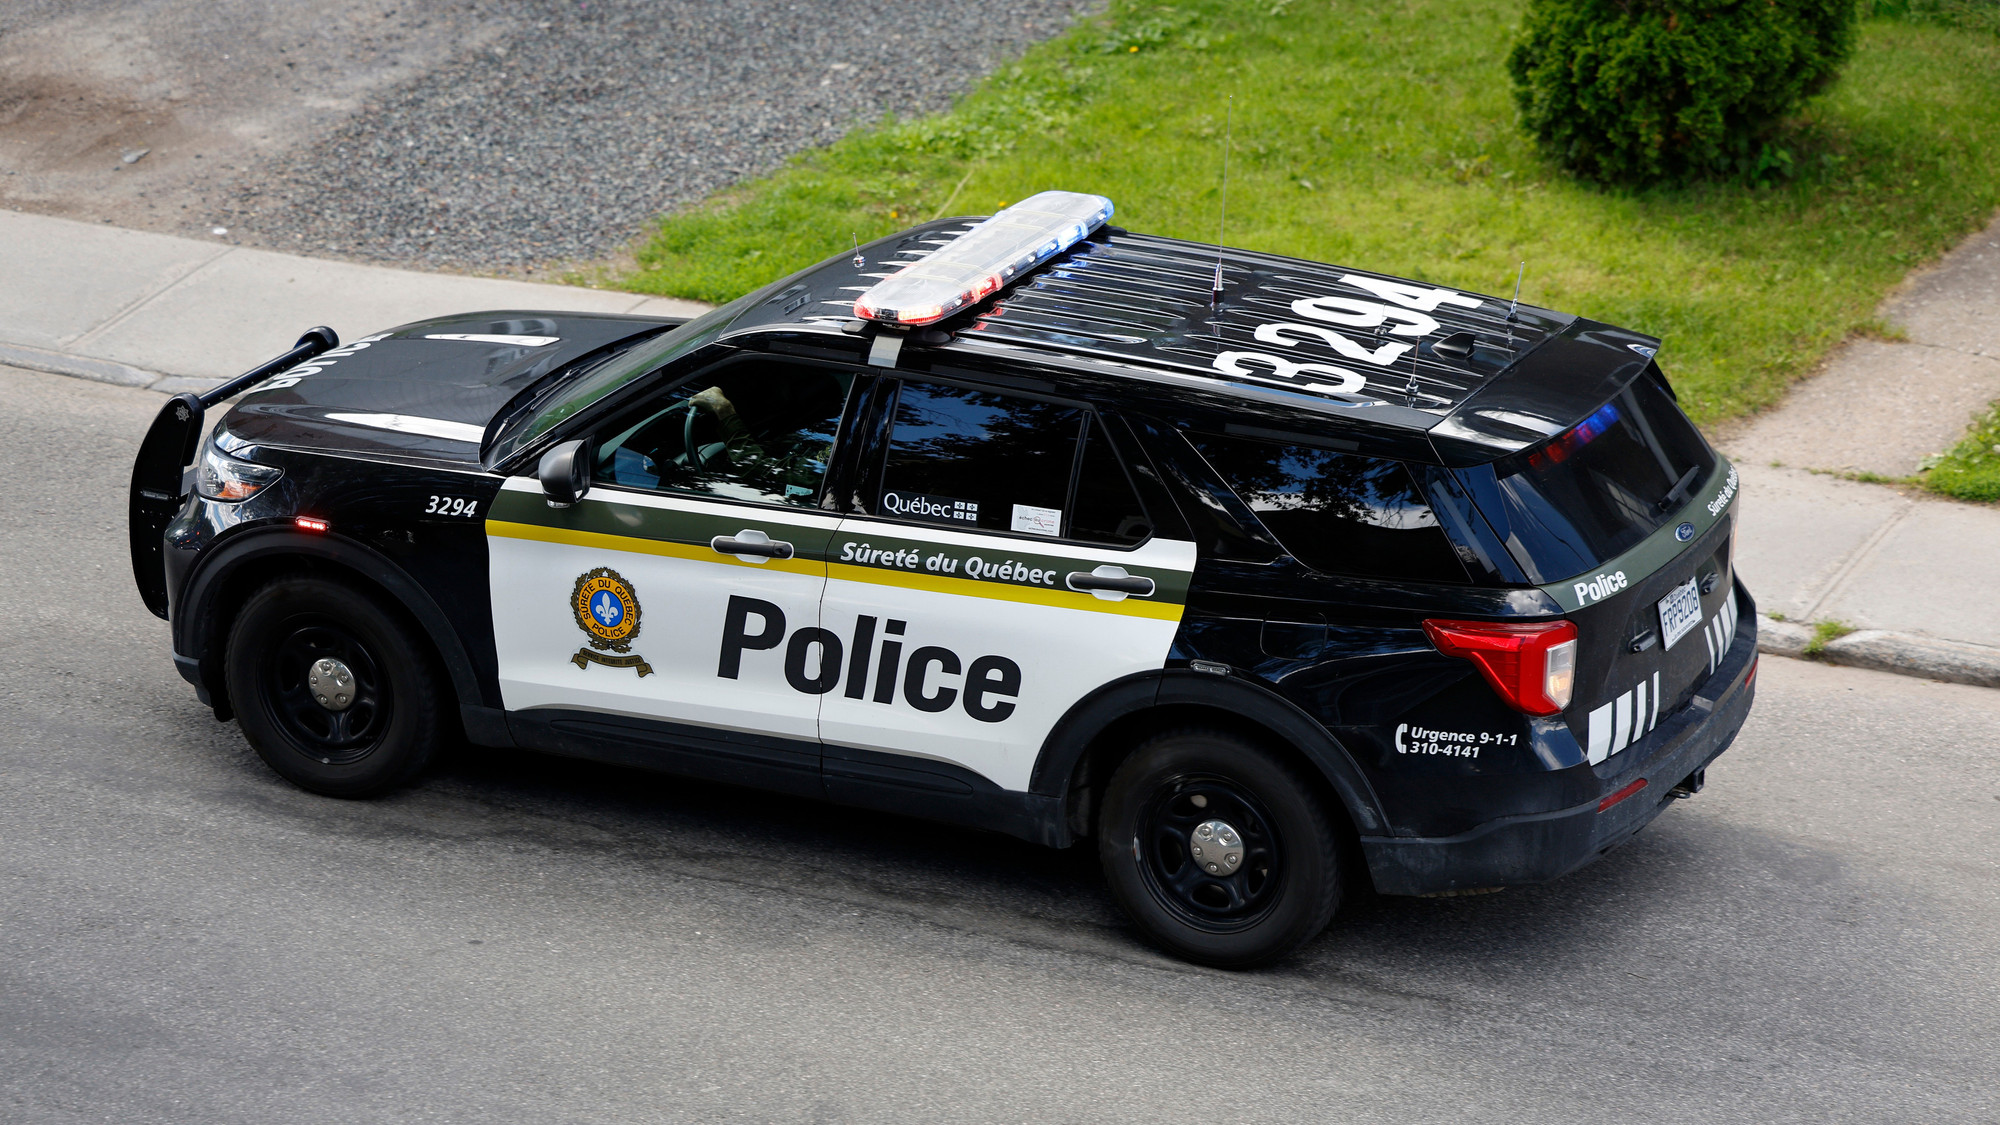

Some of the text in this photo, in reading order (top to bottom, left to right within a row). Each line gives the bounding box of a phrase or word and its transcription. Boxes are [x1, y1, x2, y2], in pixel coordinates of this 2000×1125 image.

[1213, 273, 1484, 393] 3294
[425, 495, 478, 518] 3294
[884, 492, 951, 518] Québec
[840, 541, 1057, 585] Sûreté du Québec
[598, 579, 611, 588] DU
[1574, 570, 1628, 606] Police
[1662, 586, 1699, 637] FRP9208
[592, 622, 626, 638] POLICE
[717, 594, 1022, 723] Police
[1411, 726, 1518, 746] Urgence 9-1-1
[1410, 741, 1480, 758] 310-4141
